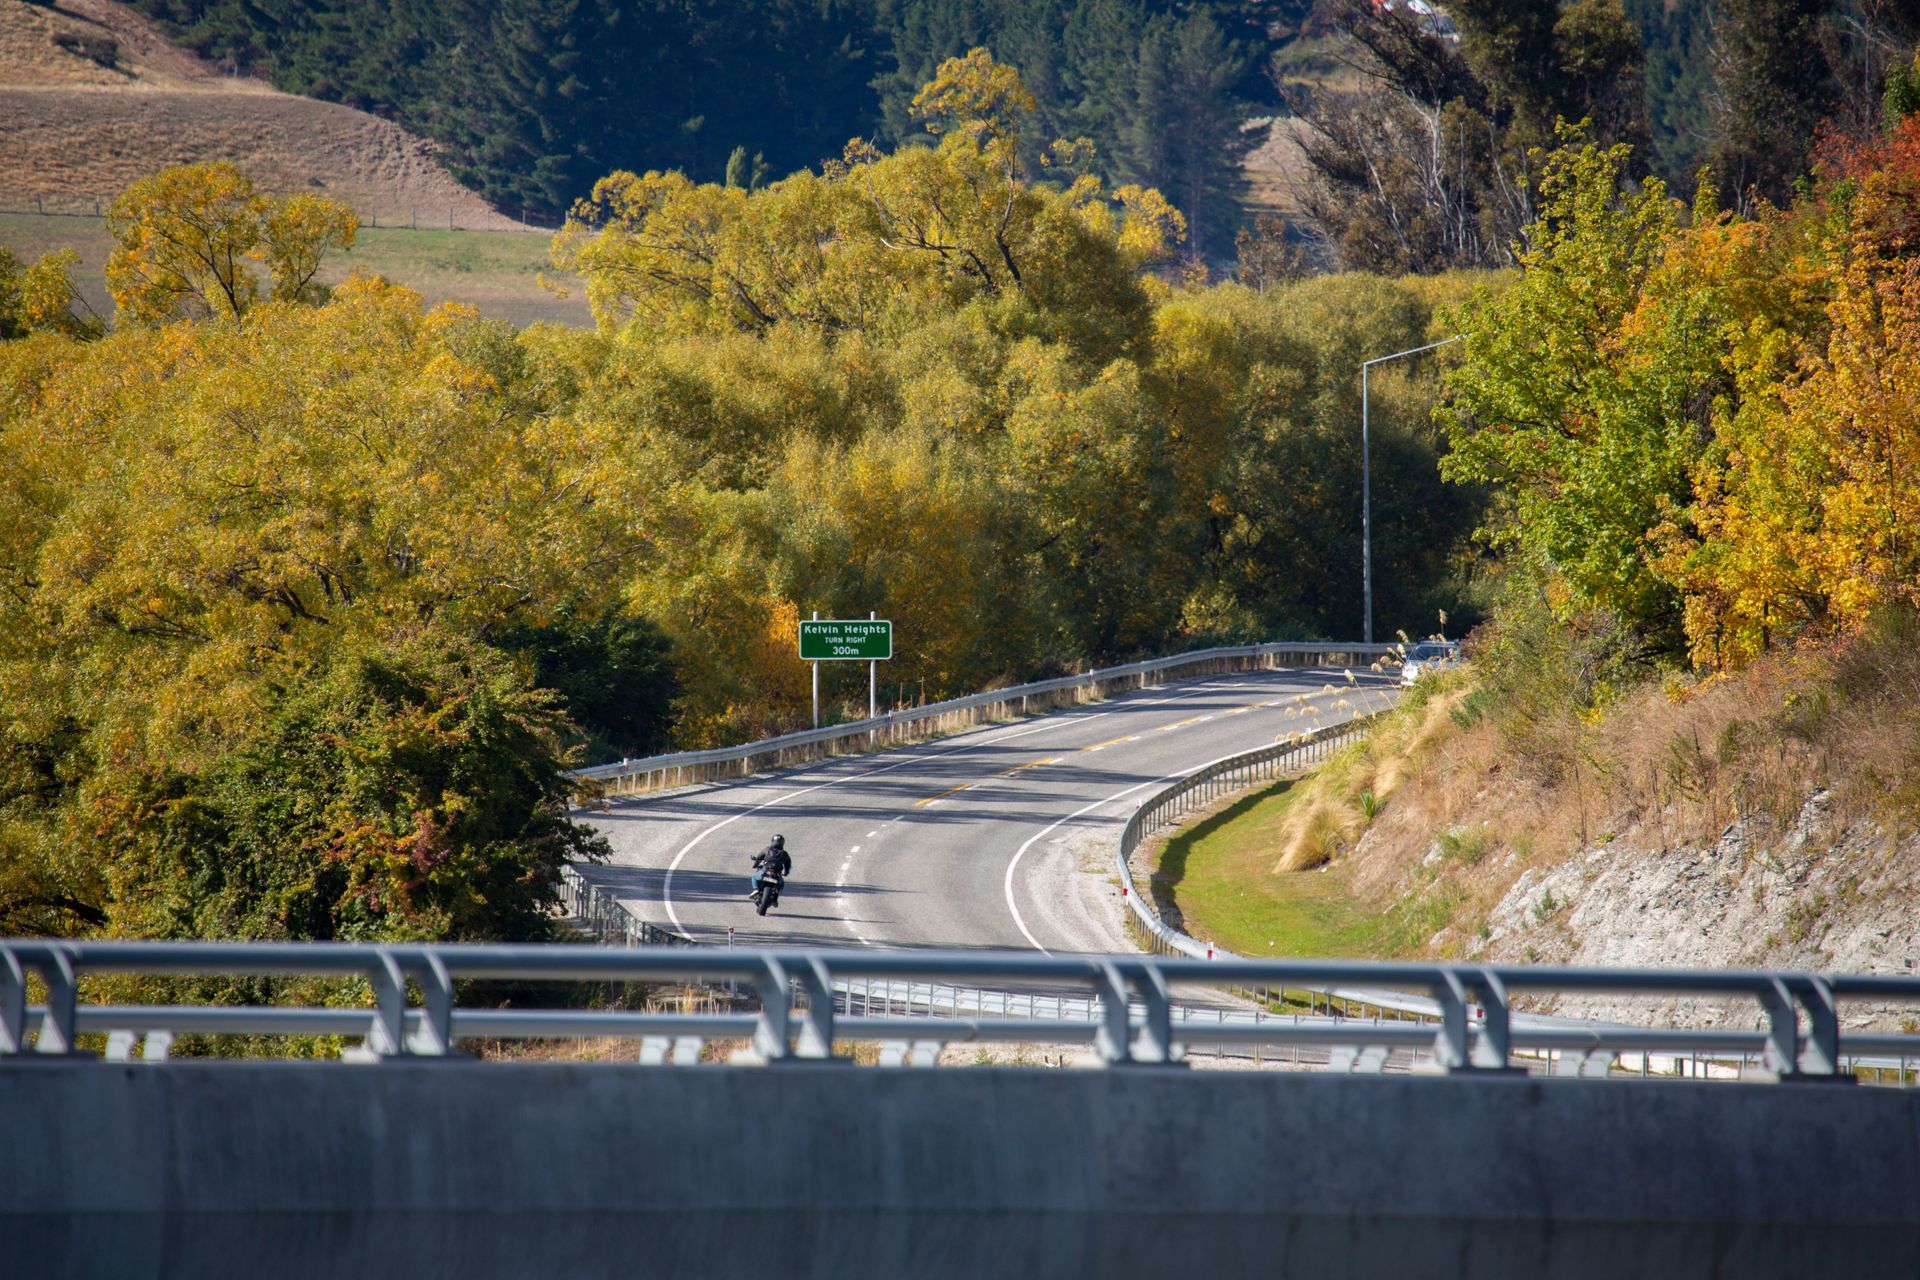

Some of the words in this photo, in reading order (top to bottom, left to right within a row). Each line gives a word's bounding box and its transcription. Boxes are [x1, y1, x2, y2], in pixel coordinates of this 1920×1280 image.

[804, 625, 839, 634] Kelvin
[844, 625, 886, 636] Heights
[824, 636, 843, 644] TURN
[846, 636, 866, 644] RIGHT
[832, 646, 859, 655] 300m
